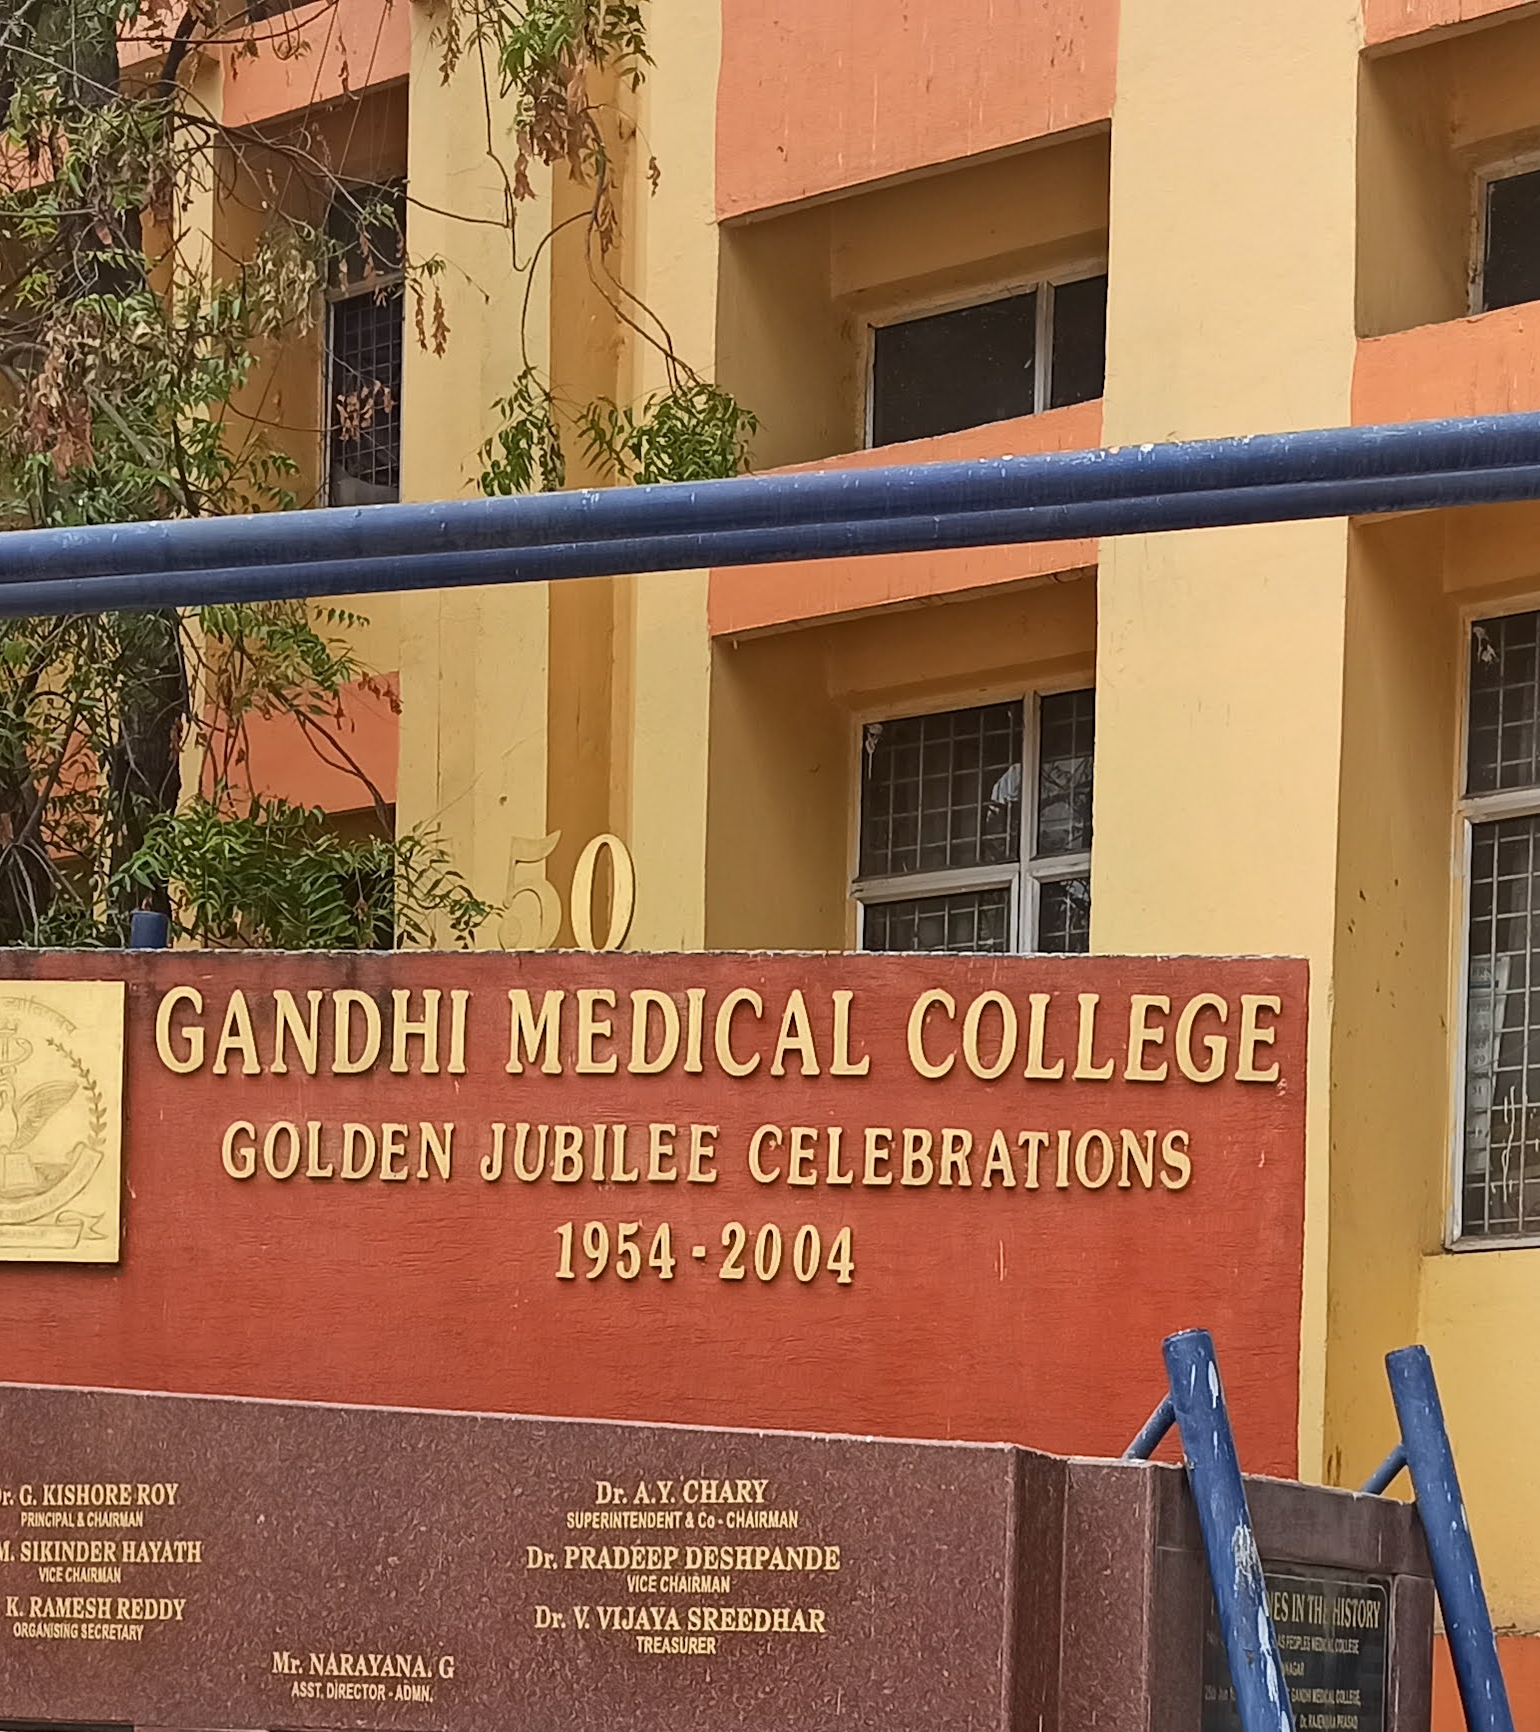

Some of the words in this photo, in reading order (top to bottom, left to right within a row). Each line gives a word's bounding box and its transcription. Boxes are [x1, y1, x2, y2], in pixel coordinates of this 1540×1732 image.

[154, 984, 466, 1077] GANDHI
[505, 988, 872, 1081] MEDICAL
[906, 990, 1284, 1085] COLLEGE
[220, 1120, 454, 1181] GOLDEN
[478, 1122, 720, 1186] JUBILEE
[747, 1125, 1195, 1193] CELEBRATIONS
[19, 1485, 37, 1505] G.
[42, 1485, 131, 1505] KISHORE
[136, 1484, 179, 1505] ROY
[595, 1481, 627, 1504] Dr.
[682, 1479, 769, 1504] CHARY
[21, 1511, 75, 1528] PRINCIPAL
[77, 1512, 85, 1528] &
[87, 1511, 144, 1528] CHAIRMAN
[566, 1511, 682, 1529] SUPERINTENDENT
[685, 1512, 695, 1529] &
[727, 1511, 798, 1529] CHAIRMAN
[20, 1541, 117, 1563] SIKINDER
[121, 1541, 202, 1563] HAYATH
[526, 1546, 558, 1569] Dr.
[564, 1546, 679, 1570] PRADEEP
[684, 1546, 841, 1571] DESHPANDE
[39, 1567, 62, 1583] VICE
[65, 1567, 121, 1583] CHAIRMAN
[627, 1575, 657, 1593] VICE
[660, 1575, 731, 1593] CHAIRMAN
[6, 1597, 24, 1618] K.
[29, 1597, 112, 1620] RAMESH
[116, 1598, 186, 1621] REDDY
[534, 1606, 566, 1630] Dr.
[574, 1607, 591, 1630] V.
[597, 1607, 681, 1631] VIJAYA
[688, 1608, 826, 1633] SREEDHAR
[1333, 1597, 1381, 1629] HISTORY
[13, 1621, 78, 1640] ORGANISING
[80, 1622, 144, 1642] SECRETARY
[636, 1636, 716, 1654] TREASURER
[271, 1652, 303, 1676] Mr.
[309, 1653, 433, 1678] NARAYANA.
[439, 1655, 455, 1679] G
[291, 1681, 324, 1699] ASST.
[327, 1681, 386, 1701] DIRECTOR
[394, 1684, 433, 1703] ADMN.
